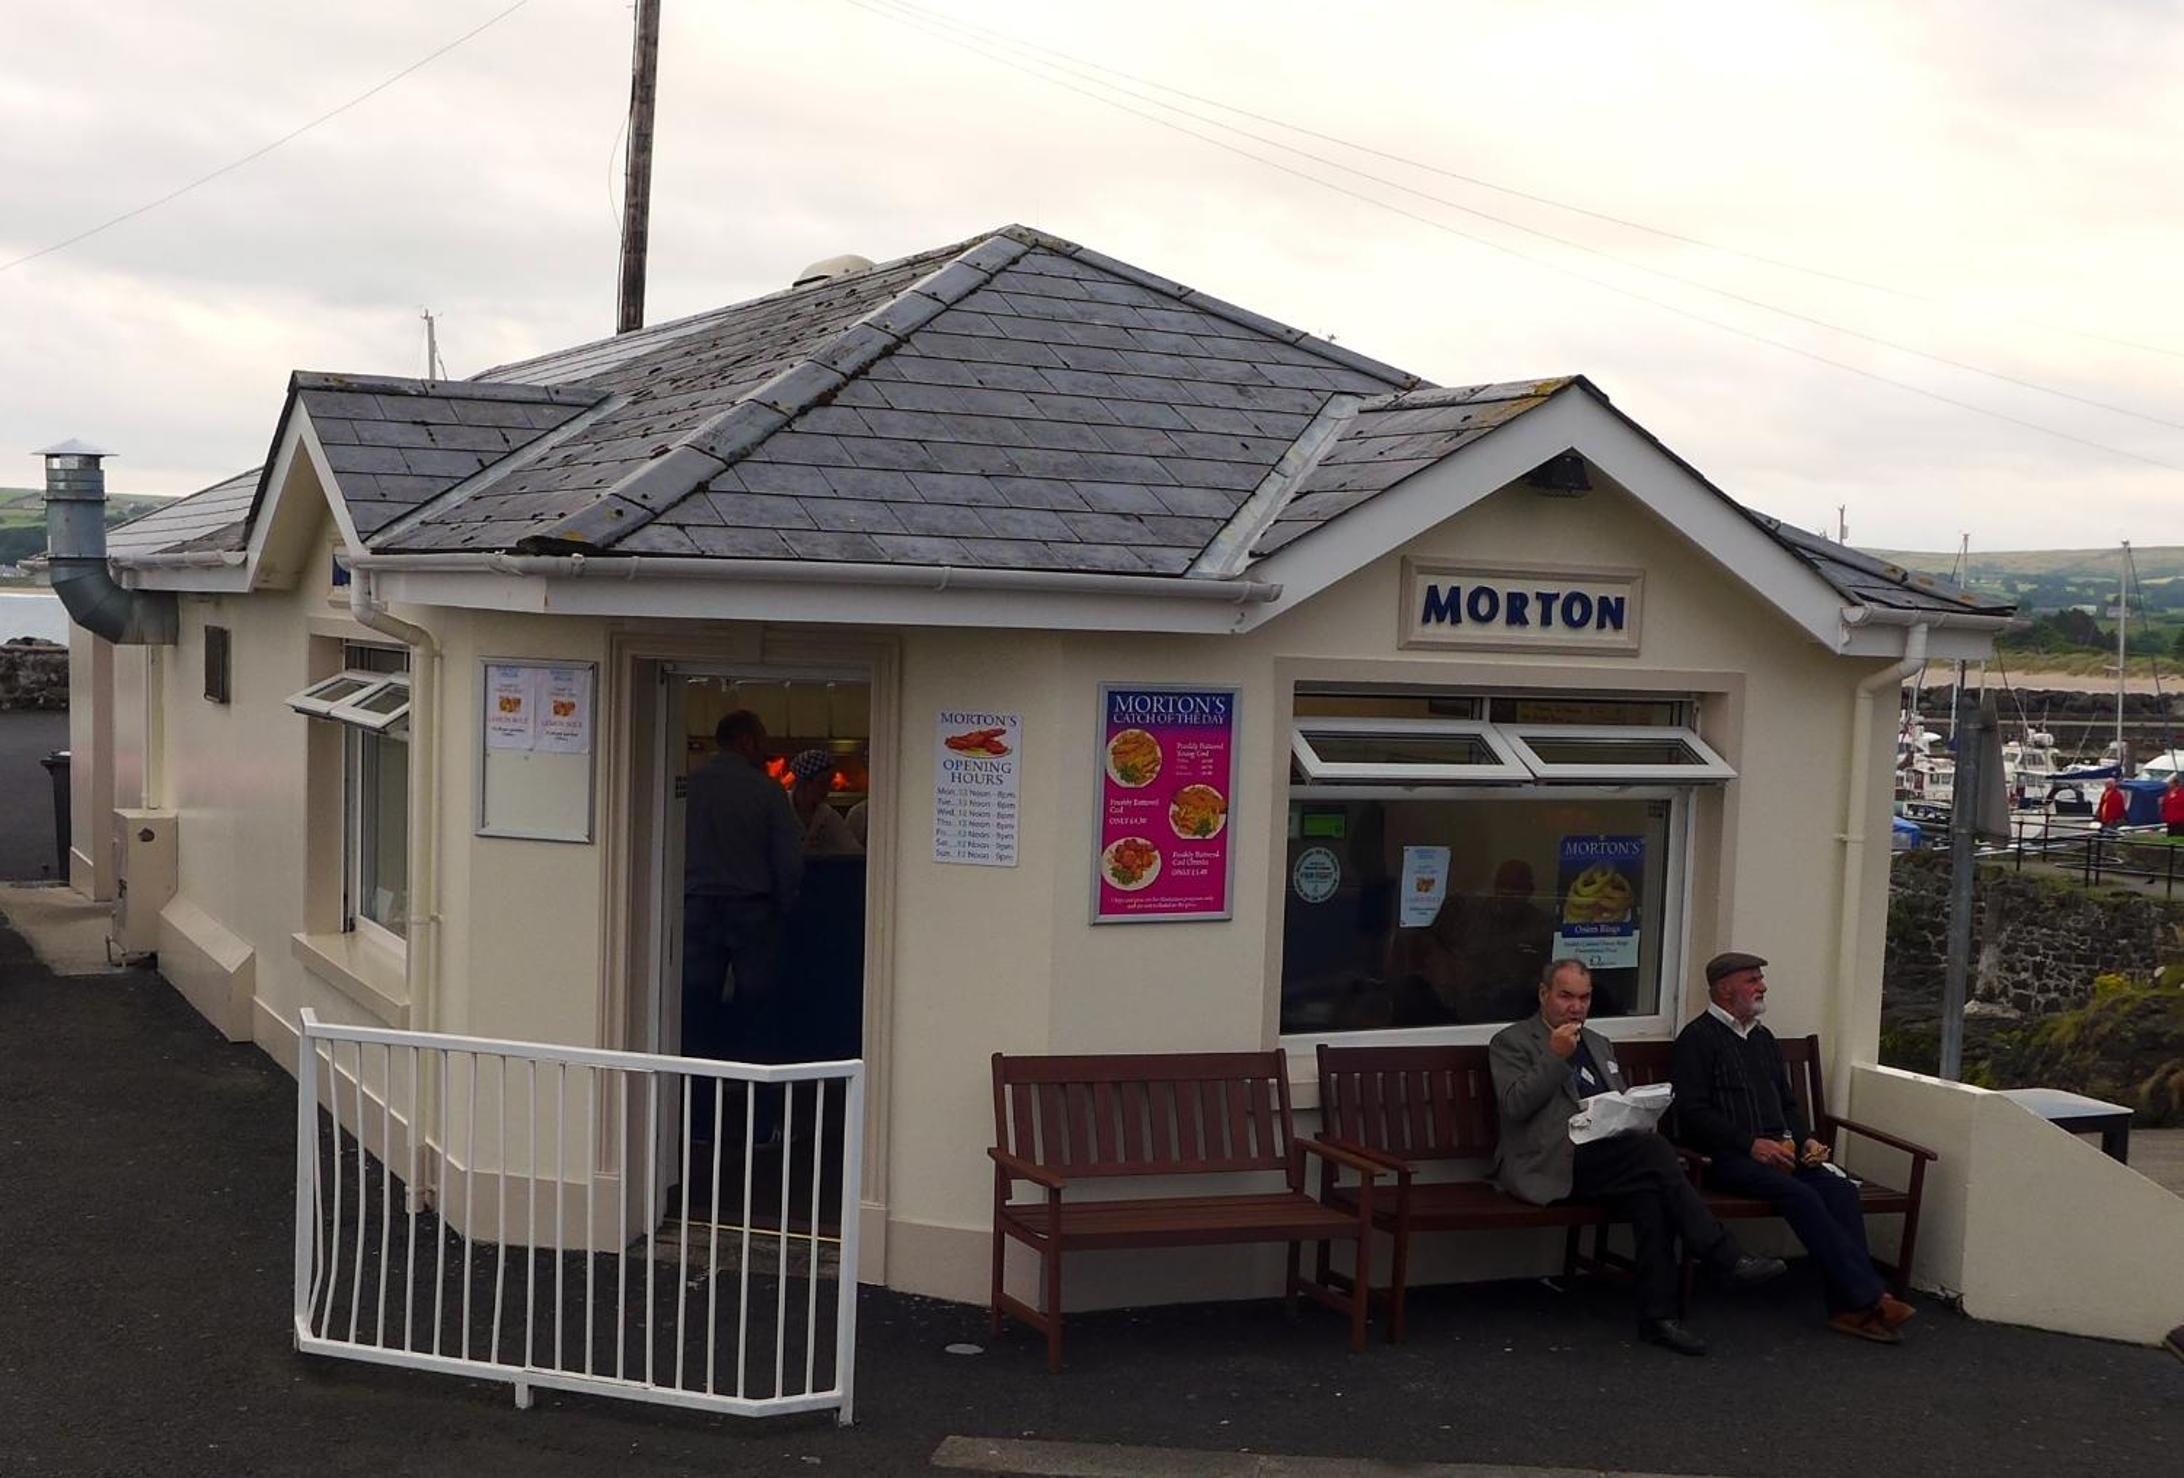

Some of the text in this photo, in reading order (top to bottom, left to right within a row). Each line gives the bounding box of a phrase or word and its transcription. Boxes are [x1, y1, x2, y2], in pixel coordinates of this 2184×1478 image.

[1421, 584, 1625, 631] MORTON
[1113, 695, 1226, 714] MORTON'S
[940, 712, 1017, 727] MORTON'S
[1113, 713, 1224, 726] CATCH OF THE DAY
[943, 760, 1012, 774] OPENING
[951, 773, 1004, 785] HOURS
[1565, 840, 1641, 857] MORTON'S
